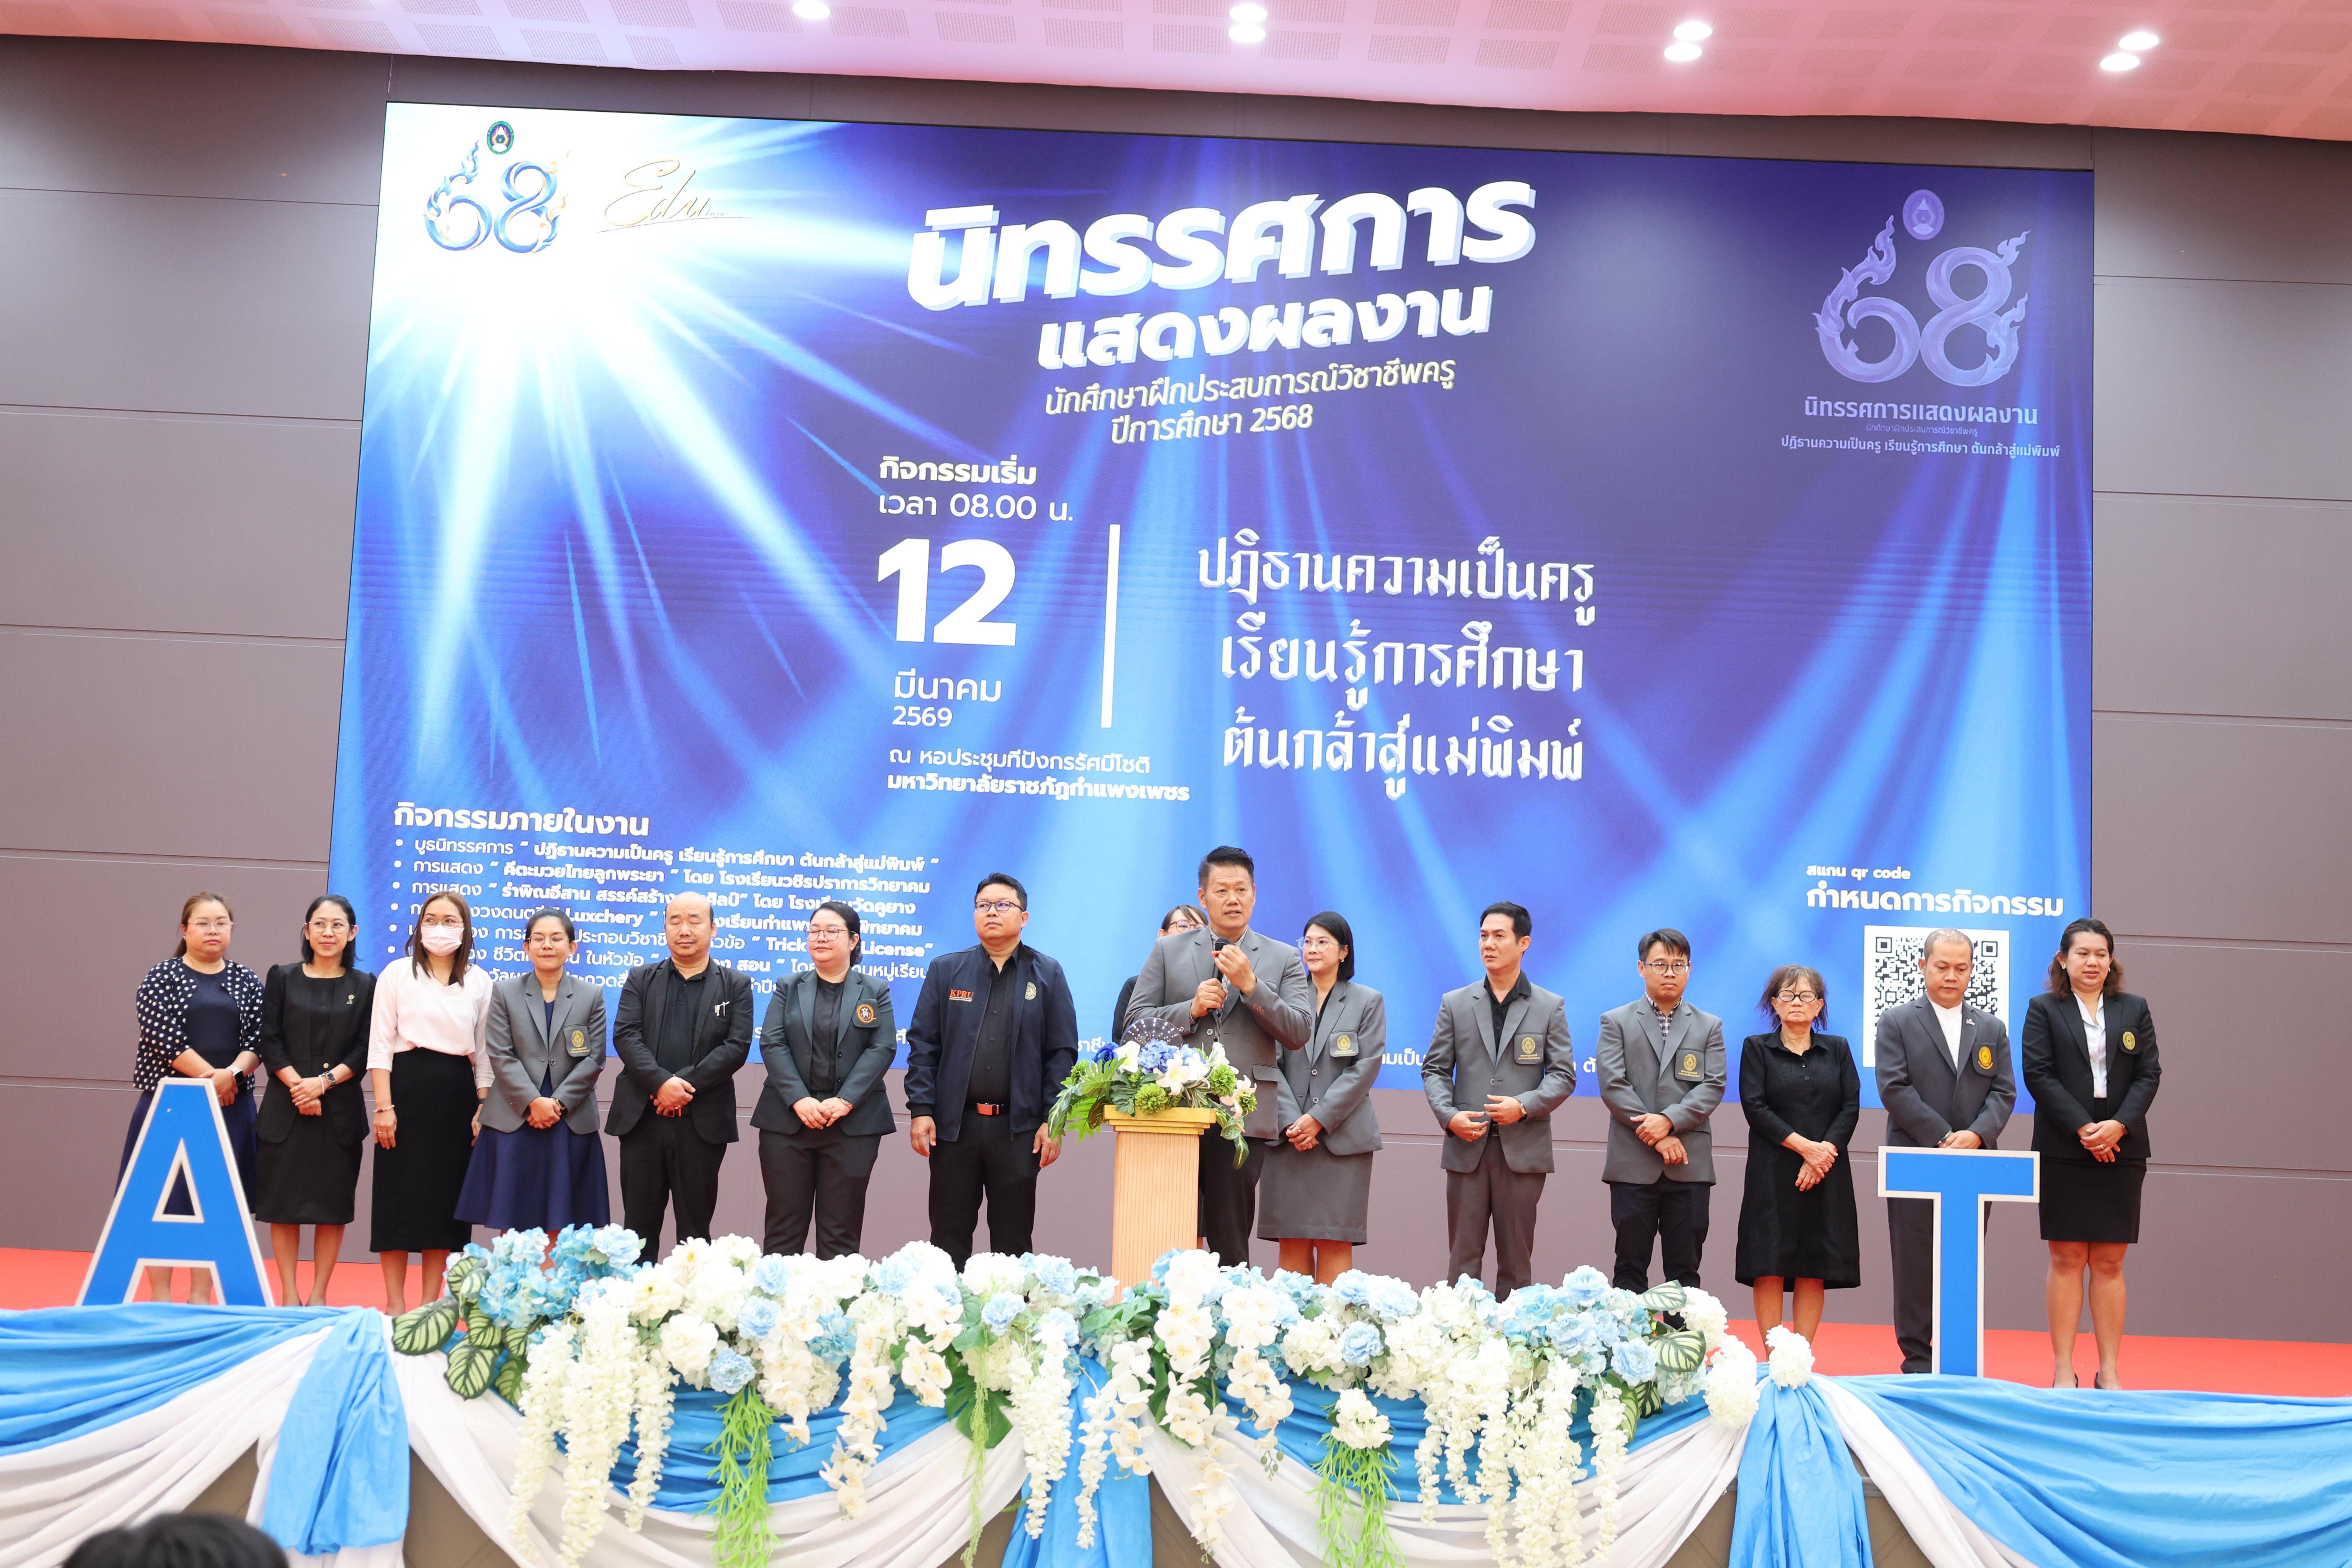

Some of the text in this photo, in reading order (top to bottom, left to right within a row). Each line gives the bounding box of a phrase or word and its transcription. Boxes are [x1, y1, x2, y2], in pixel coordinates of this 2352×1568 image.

[601, 157, 710, 227] Edu
[906, 180, 1536, 310] นิทรรศการ
[1038, 285, 1492, 368] แสดงผลงาน
[1045, 359, 1455, 415] นักศึกษาฝึกประสบการณ์วิชาชีพครู
[1110, 405, 1313, 445] ปีการศึกษา 2568
[1805, 396, 2038, 424] นิทรรศการแสดงผลงาน
[1885, 440, 1968, 456] เรียนรู้การศึกษา
[1972, 443, 2060, 459] ต้นกล้าสู่แม่พิมพ์
[880, 455, 1037, 485] กิจกรรมเริ่ม
[879, 493, 1073, 521] เวลา 08.00 น.
[878, 539, 1016, 646] 12
[1221, 612, 1583, 711] เรียนรู้การศึกษา
[894, 668, 1002, 702] มีนาคม
[893, 706, 953, 727] 2569
[889, 747, 1150, 774] ณ หอประชุมทีปังกรรัศมีโชติ
[1223, 706, 1583, 800] ต้นกล้าสู่แม่พิมพ์
[887, 773, 1190, 801] มหาวิทยาลัยราชภัฏกำแพงเพชร
[394, 802, 649, 837] กิจกรรมภายในงาน
[415, 838, 514, 855] บูธนิทรรศการ
[679, 847, 795, 869] เรียนรู้การศึกษา
[800, 851, 925, 874] ต้นกล้าสู่แม่พิมพ์
[1806, 865, 1911, 881] สแกน qr code
[414, 860, 483, 875] การแสดง
[504, 860, 664, 884] คีตะมวยไทยลูกพระยา
[683, 869, 714, 884] โดย
[719, 870, 931, 894] โรงเรียนวชิรปราการวิทยาคม
[502, 881, 591, 901] รำพิณอีสาน
[753, 893, 784, 909] โดย
[1806, 880, 2064, 916] กำหนดการกิจกรรม
[565, 907, 644, 927] Luxchery
[586, 949, 644, 967] ในหัวข้อ
[736, 959, 771, 972] สอน
[766, 936, 808, 952] Trick
[950, 989, 975, 998] KPRU
[76, 1077, 274, 1307] A
[1877, 1145, 2040, 1377] T
